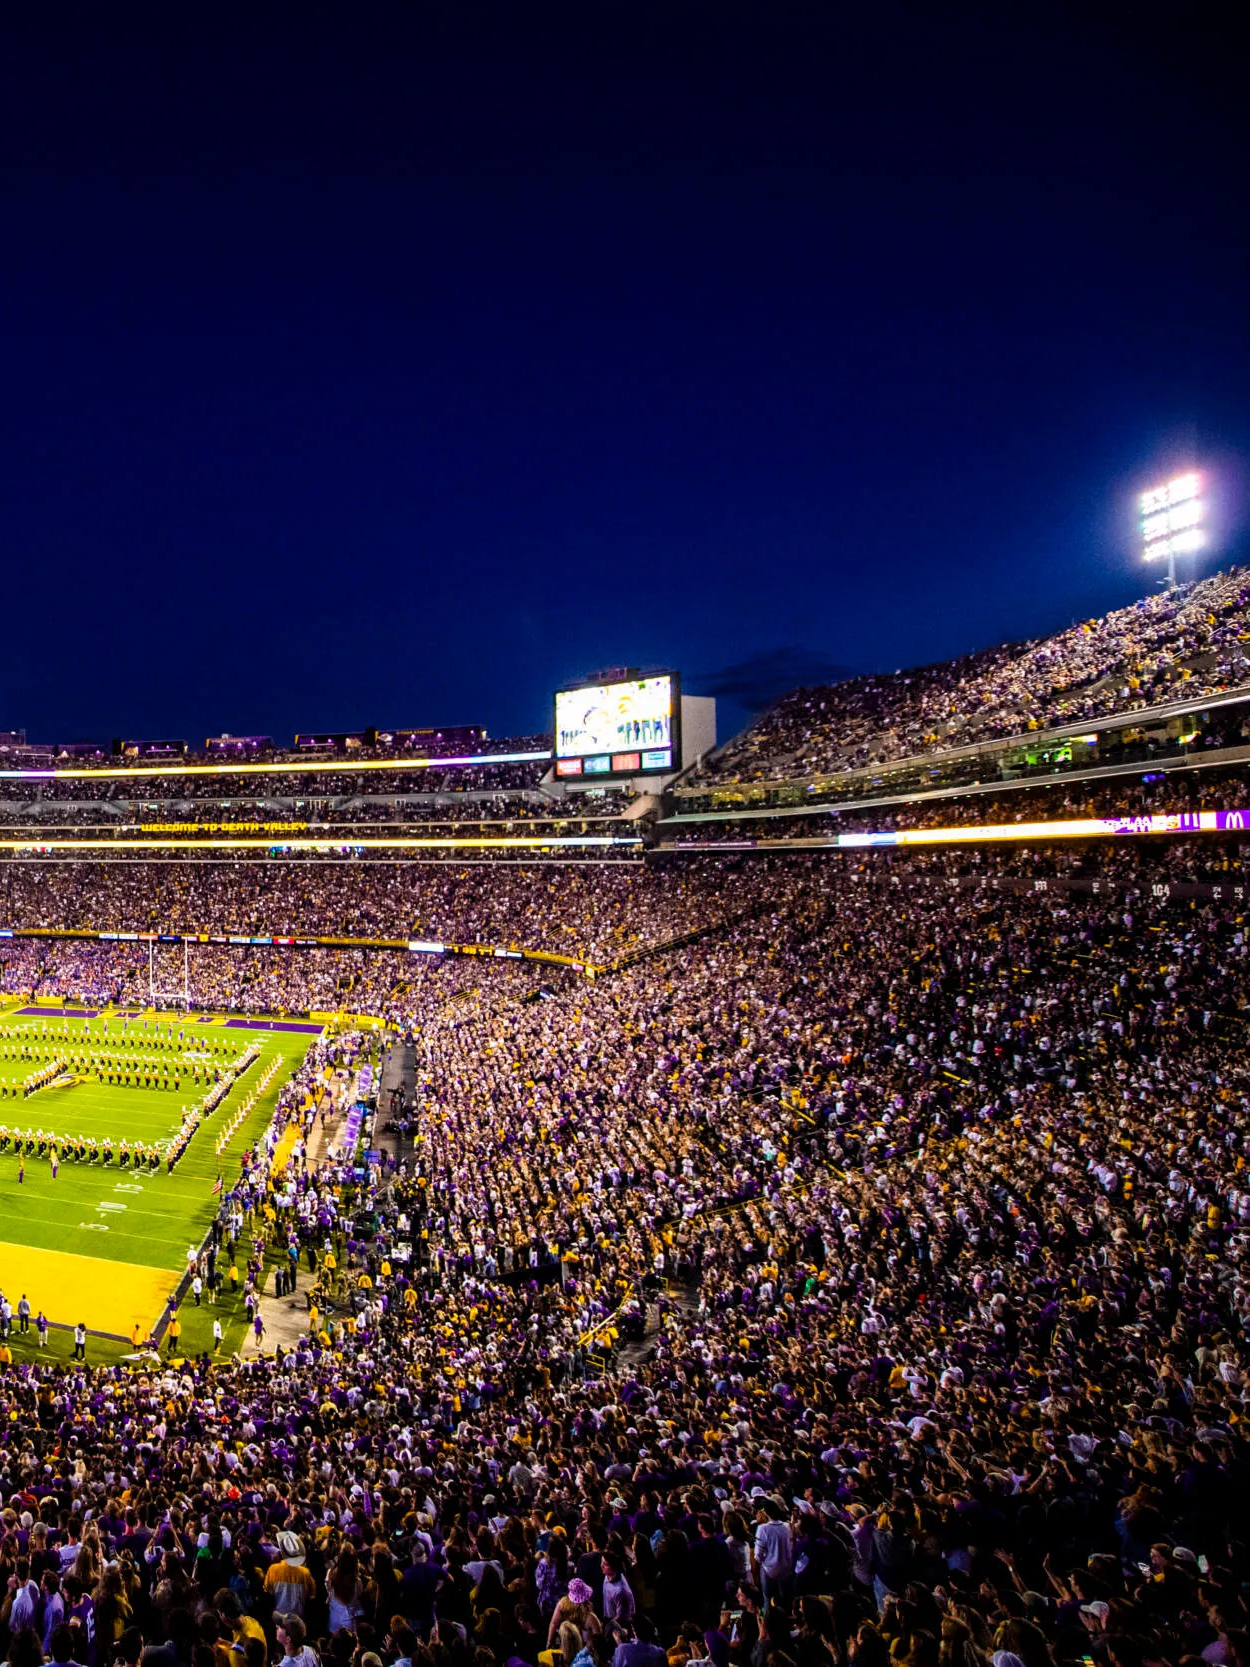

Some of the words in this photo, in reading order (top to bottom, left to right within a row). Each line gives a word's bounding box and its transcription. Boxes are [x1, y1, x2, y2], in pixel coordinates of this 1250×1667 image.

[141, 823, 199, 832] WELCOME
[204, 823, 217, 831] TO
[221, 823, 259, 831] DEATH
[263, 822, 307, 831] VALLEY
